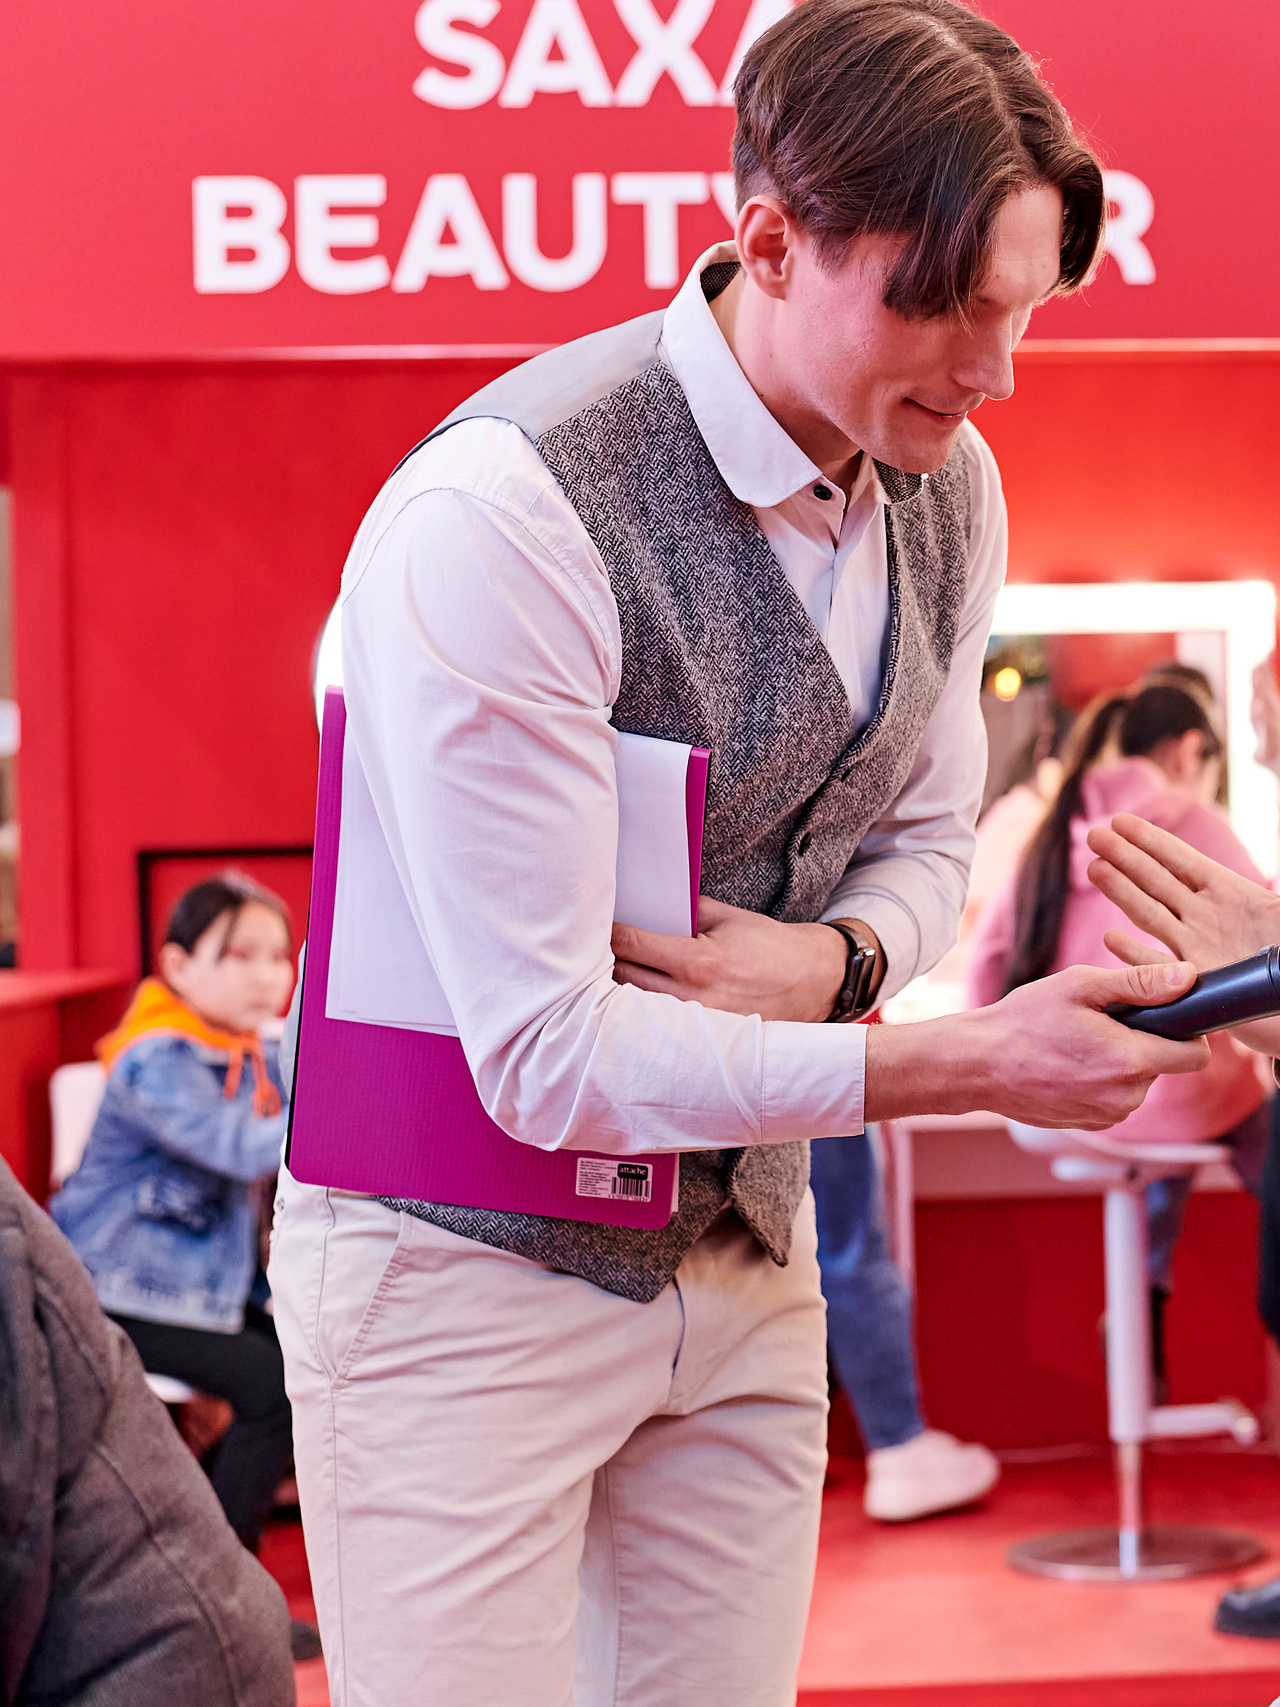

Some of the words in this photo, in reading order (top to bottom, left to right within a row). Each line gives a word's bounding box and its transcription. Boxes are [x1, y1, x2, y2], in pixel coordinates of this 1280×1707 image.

[412, 0, 796, 110] SAX
[192, 171, 738, 295] BEAUT
[619, 1166, 646, 1175] attache
